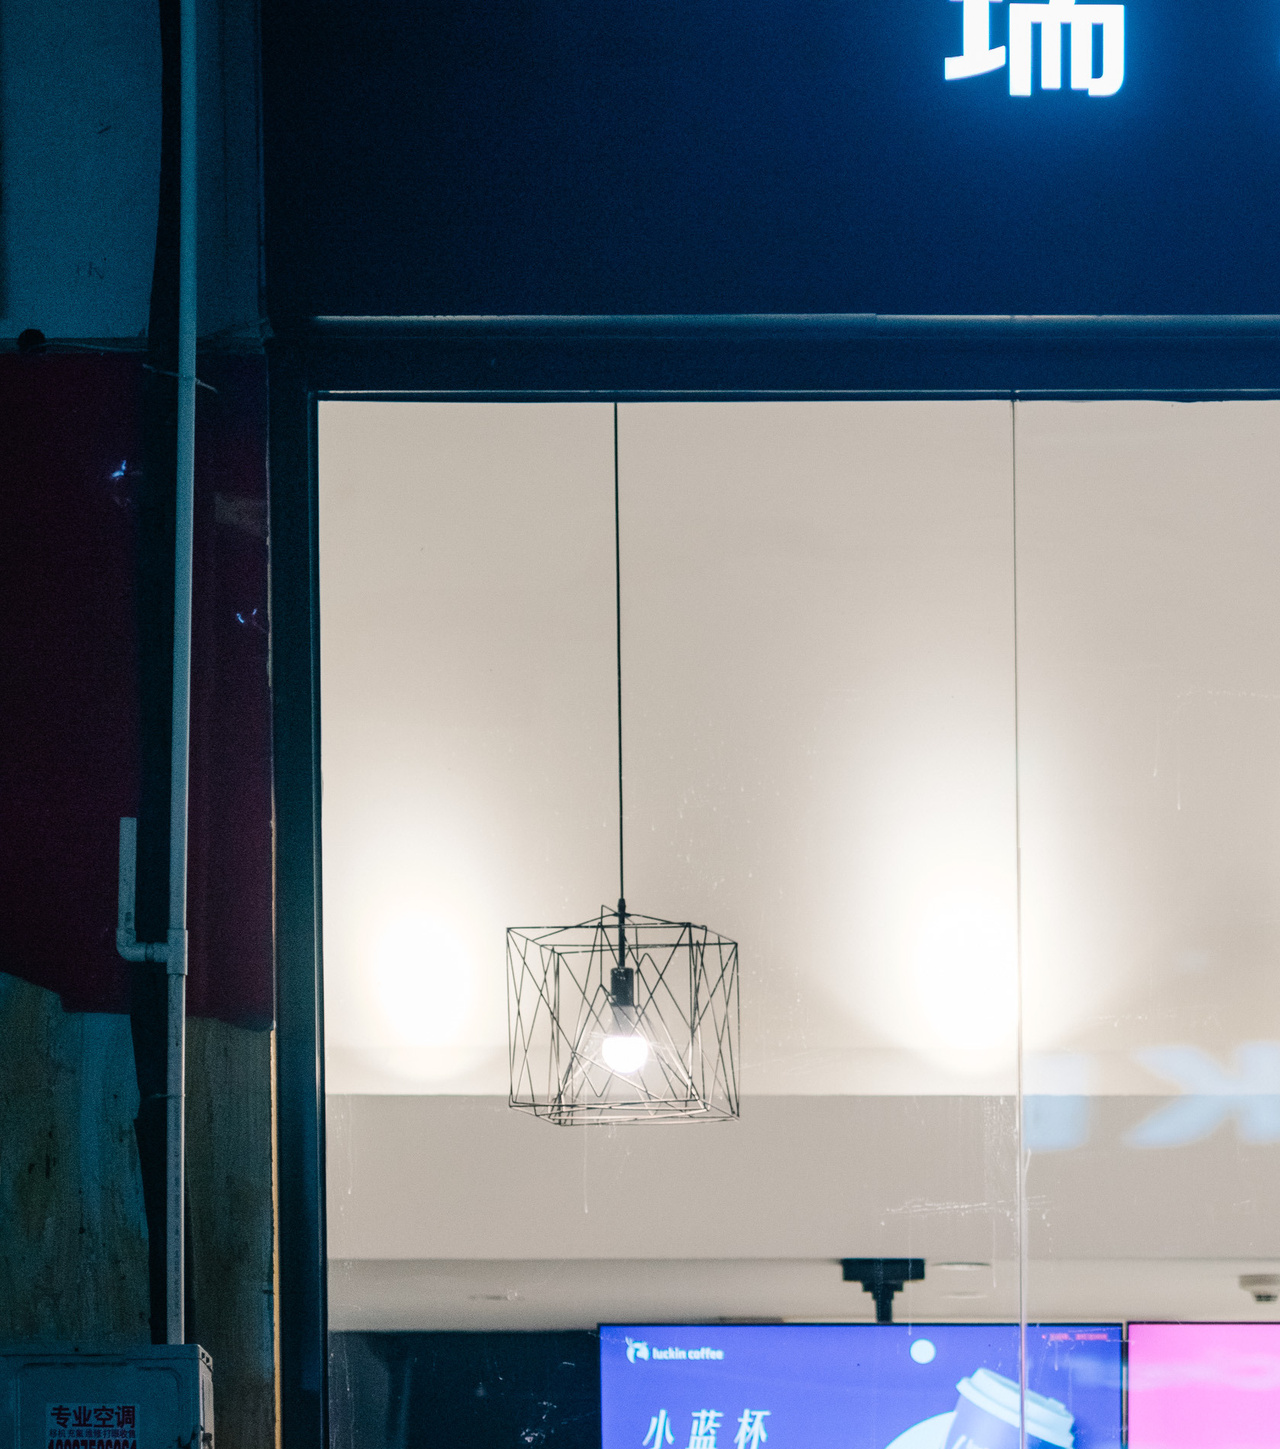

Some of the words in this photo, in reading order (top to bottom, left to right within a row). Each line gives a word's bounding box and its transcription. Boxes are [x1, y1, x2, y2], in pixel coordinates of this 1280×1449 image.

[652, 1346, 687, 1360] luckin
[688, 1346, 724, 1360] coffee
[51, 1405, 135, 1428] 专业空调
